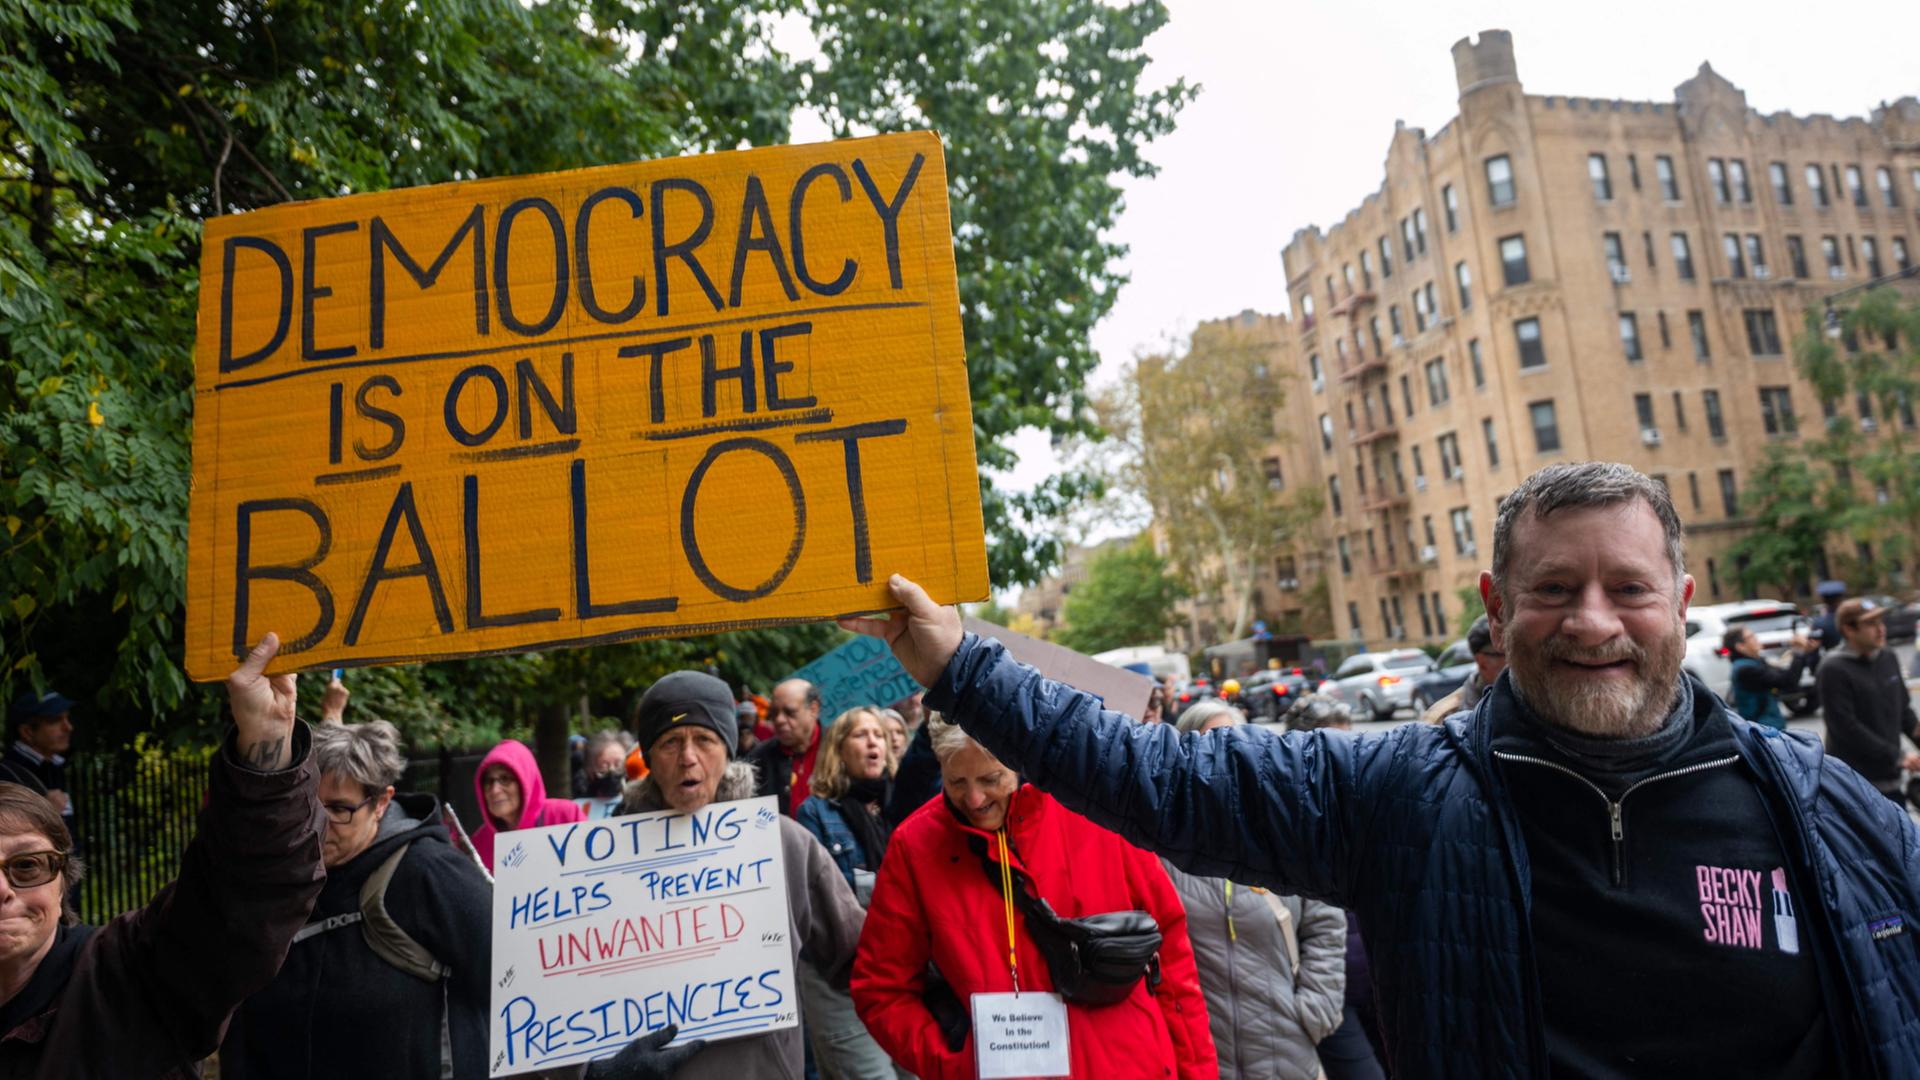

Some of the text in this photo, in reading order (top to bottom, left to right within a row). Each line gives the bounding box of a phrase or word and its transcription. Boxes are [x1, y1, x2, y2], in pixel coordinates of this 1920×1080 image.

[219, 152, 926, 373] DEMOCRACY
[329, 321, 818, 465] IS ON THE
[231, 420, 907, 659] BALLOT
[836, 637, 889, 667] YOU
[866, 673, 918, 707] VOTE
[548, 807, 748, 867] VOTING
[510, 858, 773, 930] HELPS PREVENT
[1695, 865, 1762, 909] BECKY
[538, 903, 745, 971] UNWANTED
[1700, 903, 1762, 949] SHAW
[500, 969, 783, 1066] PRESIDENCIES
[992, 1013, 1043, 1022] We Believe
[1017, 1027, 1032, 1036] the
[990, 1040, 1050, 1051] Constitution!
